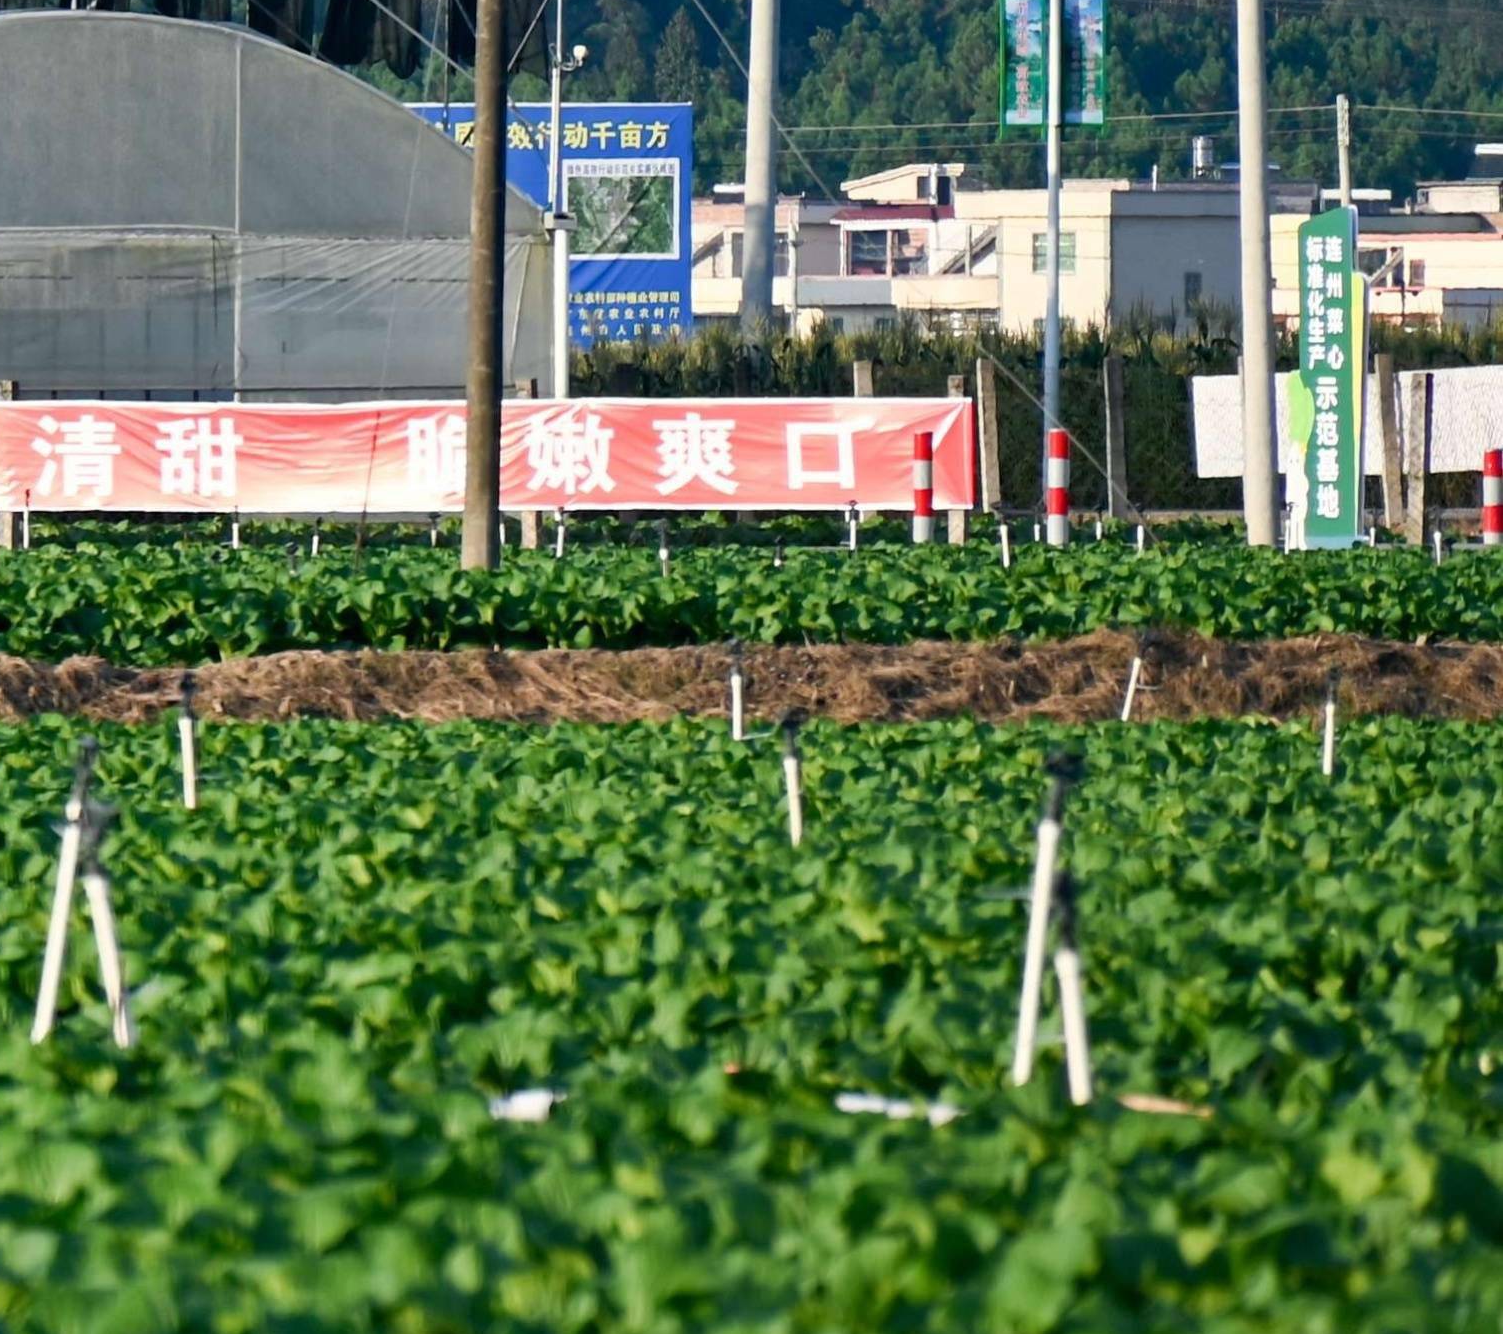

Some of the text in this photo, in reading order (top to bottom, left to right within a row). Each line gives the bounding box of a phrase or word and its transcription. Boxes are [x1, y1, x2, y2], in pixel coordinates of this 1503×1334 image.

[1306, 235, 1326, 370] 标准化生产
[1325, 235, 1344, 370] 连州菜心
[1316, 377, 1340, 519] 示范基地
